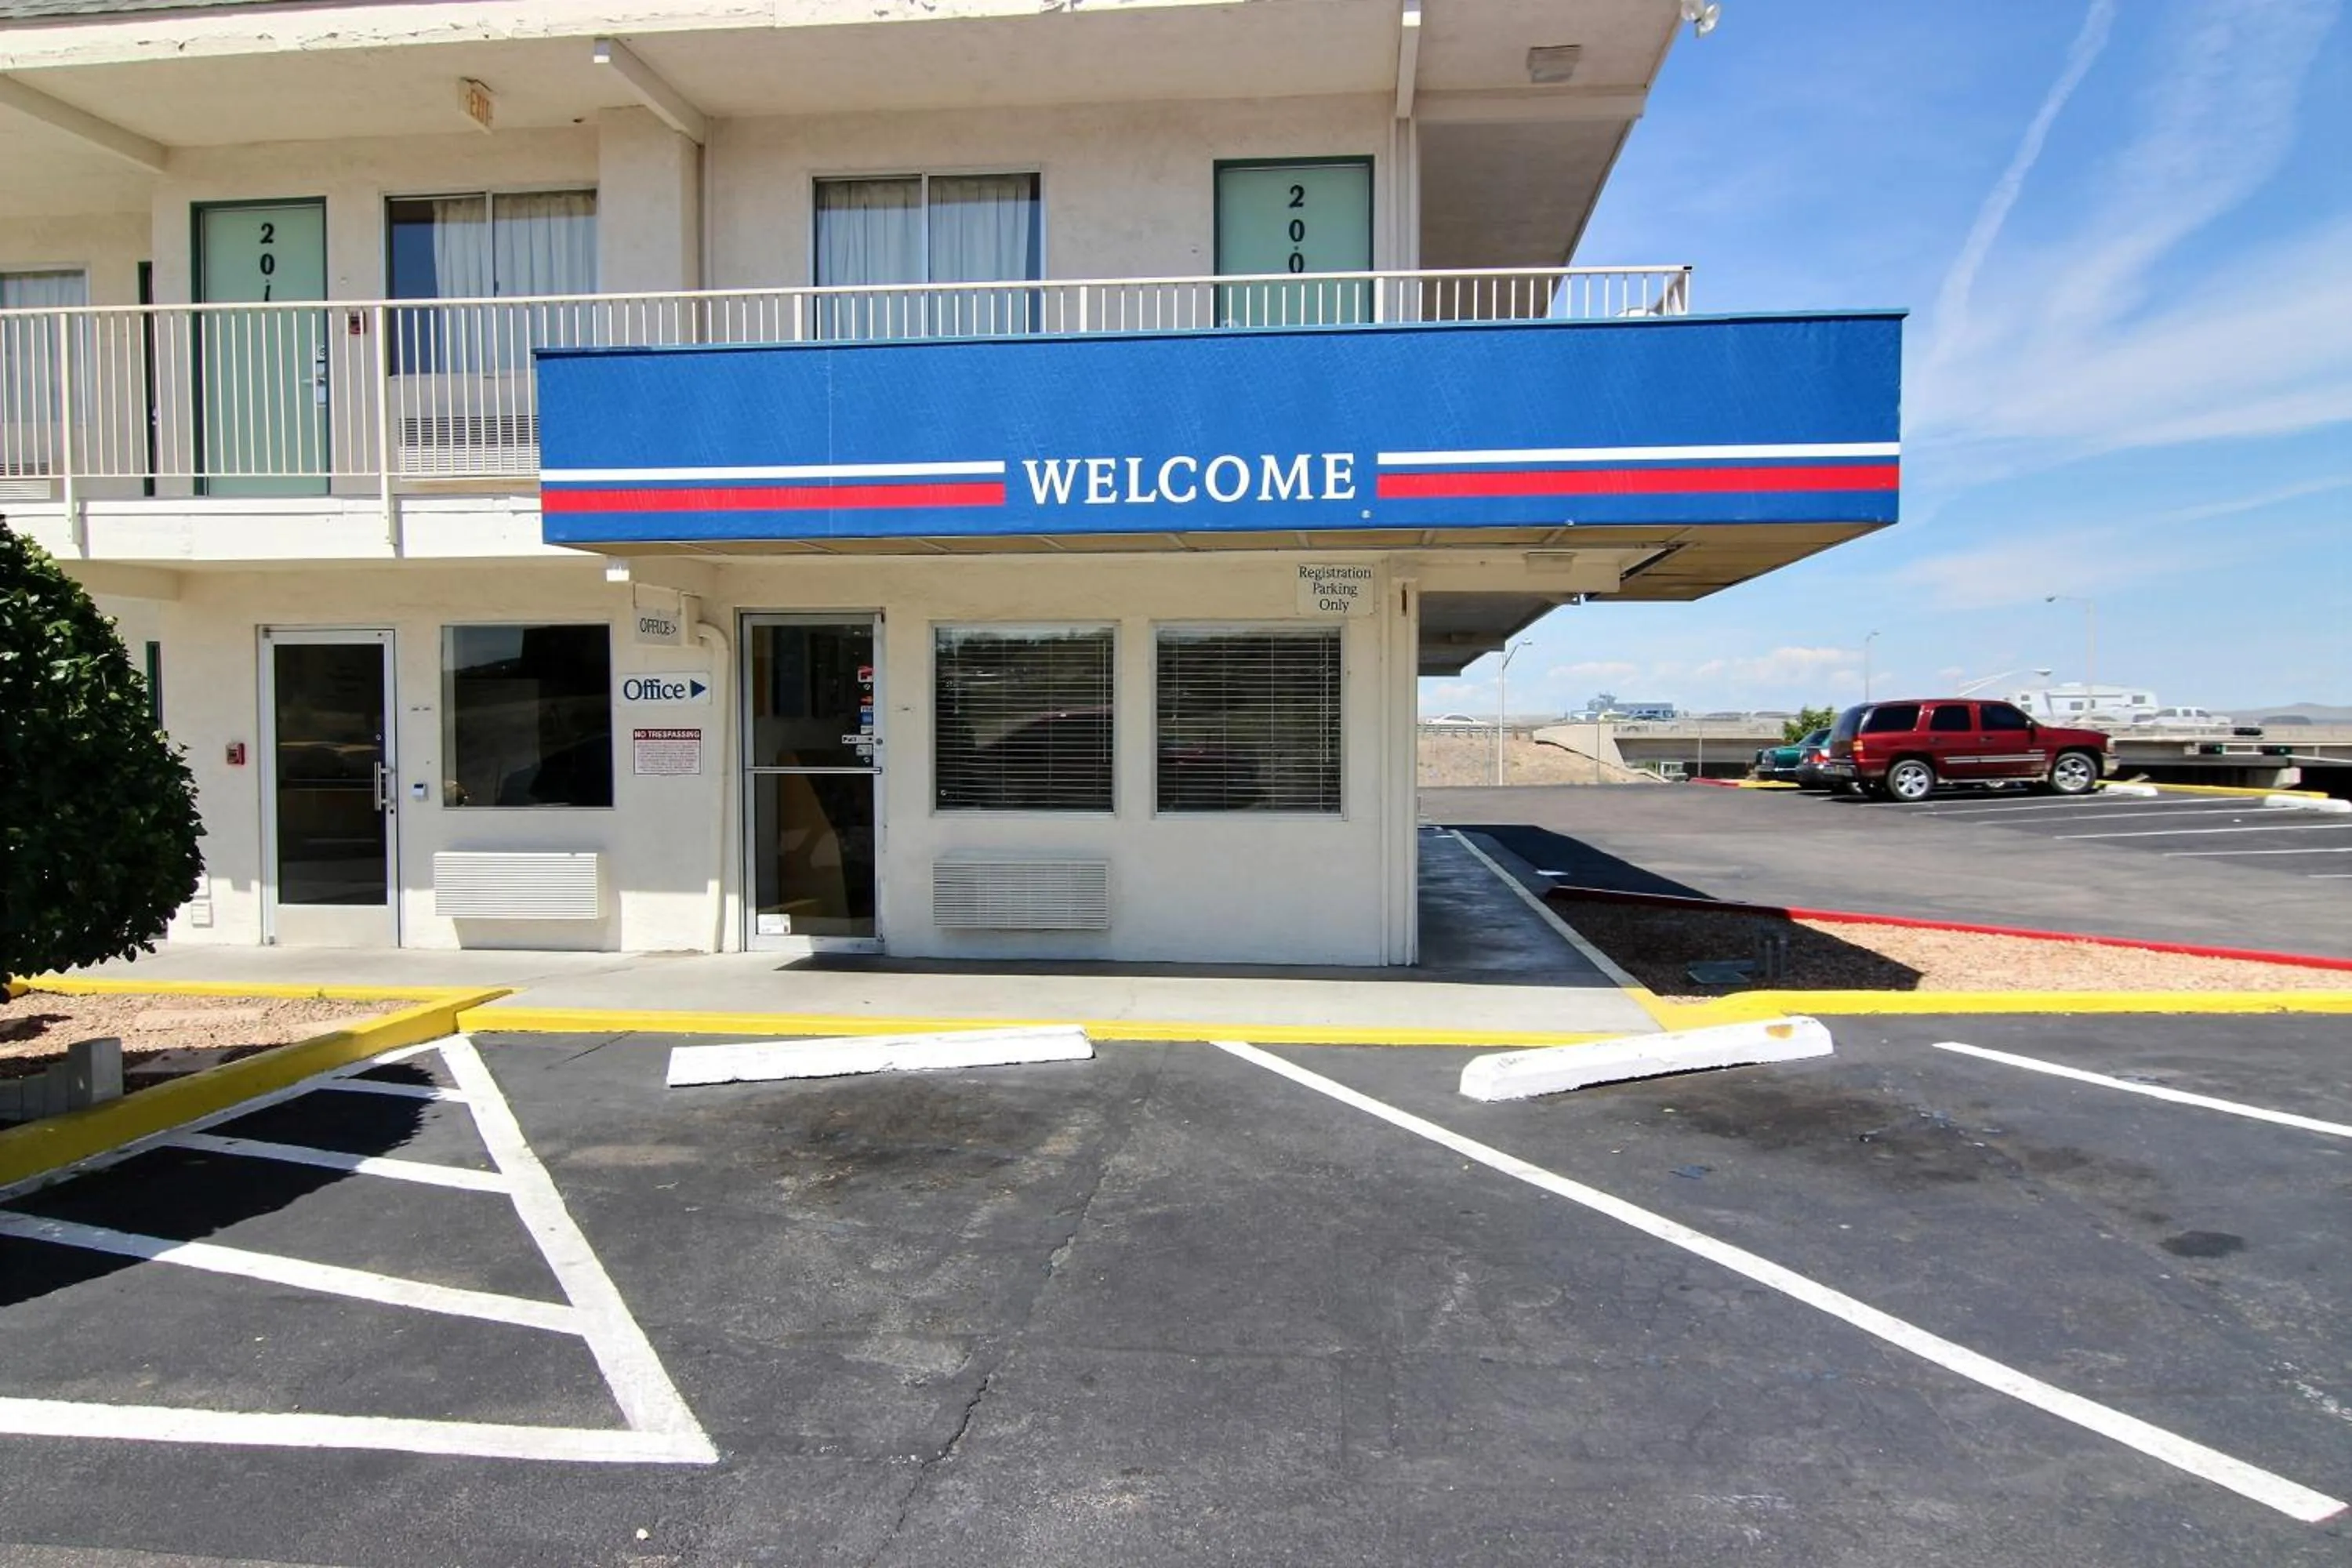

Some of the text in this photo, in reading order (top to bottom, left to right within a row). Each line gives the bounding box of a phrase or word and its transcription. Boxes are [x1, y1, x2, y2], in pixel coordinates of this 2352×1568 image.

[1022, 452, 1356, 505] WELCOME
[1298, 566, 1372, 581] Registration
[1312, 583, 1359, 597] Parking
[1319, 598, 1350, 613] Only
[623, 678, 686, 701] Office
